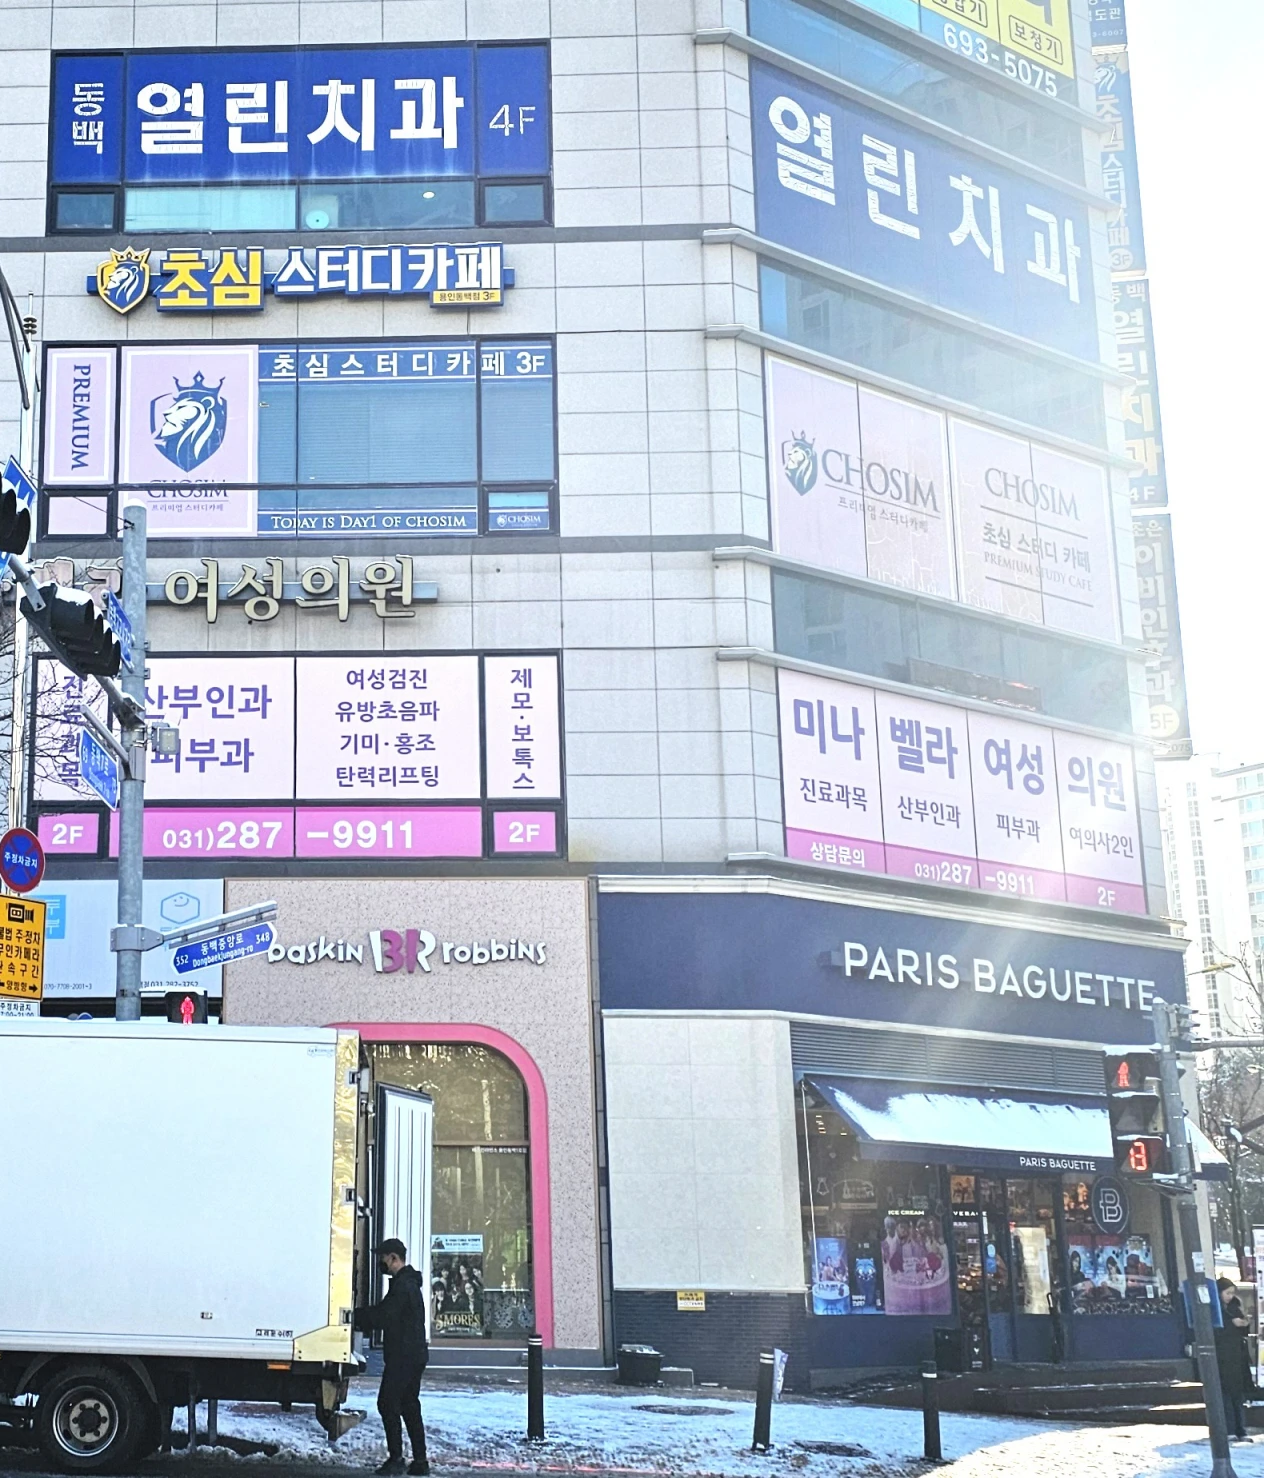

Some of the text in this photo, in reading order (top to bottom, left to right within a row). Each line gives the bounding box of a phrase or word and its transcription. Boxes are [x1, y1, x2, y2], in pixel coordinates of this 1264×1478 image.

[943, 23, 1058, 97] 693-5075
[1014, 22, 1058, 59] 보청기
[72, 82, 105, 155] 동백
[137, 76, 535, 155] 열린치과 4F
[767, 96, 1081, 304] 열린치과
[159, 246, 502, 307] 초심 스터디카페
[516, 351, 546, 374] 3F
[70, 363, 92, 471] PREMIUM
[821, 448, 941, 514] CHOSIM
[984, 467, 1081, 521] CHOSIM
[270, 514, 318, 530] TODAY
[321, 515, 335, 529] IS
[382, 515, 401, 529] OF
[405, 514, 466, 529] CHOSIM
[982, 521, 1011, 549] 초심
[984, 551, 1034, 576] PREMIUM
[165, 554, 417, 624] 여성의원
[345, 667, 428, 691] 여성검진
[335, 701, 441, 724] 유방초음파
[335, 763, 441, 789] 탄력리프팅
[793, 698, 1127, 812] 미나 벨라 여성 의원
[799, 777, 868, 812] 진료과목
[896, 795, 962, 829] 산부인과
[995, 812, 1041, 843] 피부과
[51, 822, 84, 846] 2F
[163, 819, 283, 852] 031)287
[508, 821, 541, 844] 2F
[809, 840, 866, 868] 상담문의
[1097, 886, 1117, 907] 2F
[175, 931, 270, 967] 352 348
[200, 933, 244, 956] 동백중앙로
[267, 935, 364, 965] baskin
[843, 941, 1156, 1012] PARIS BAGUETTE
[1019, 1156, 1097, 1171] PARIS BAGUETTE
